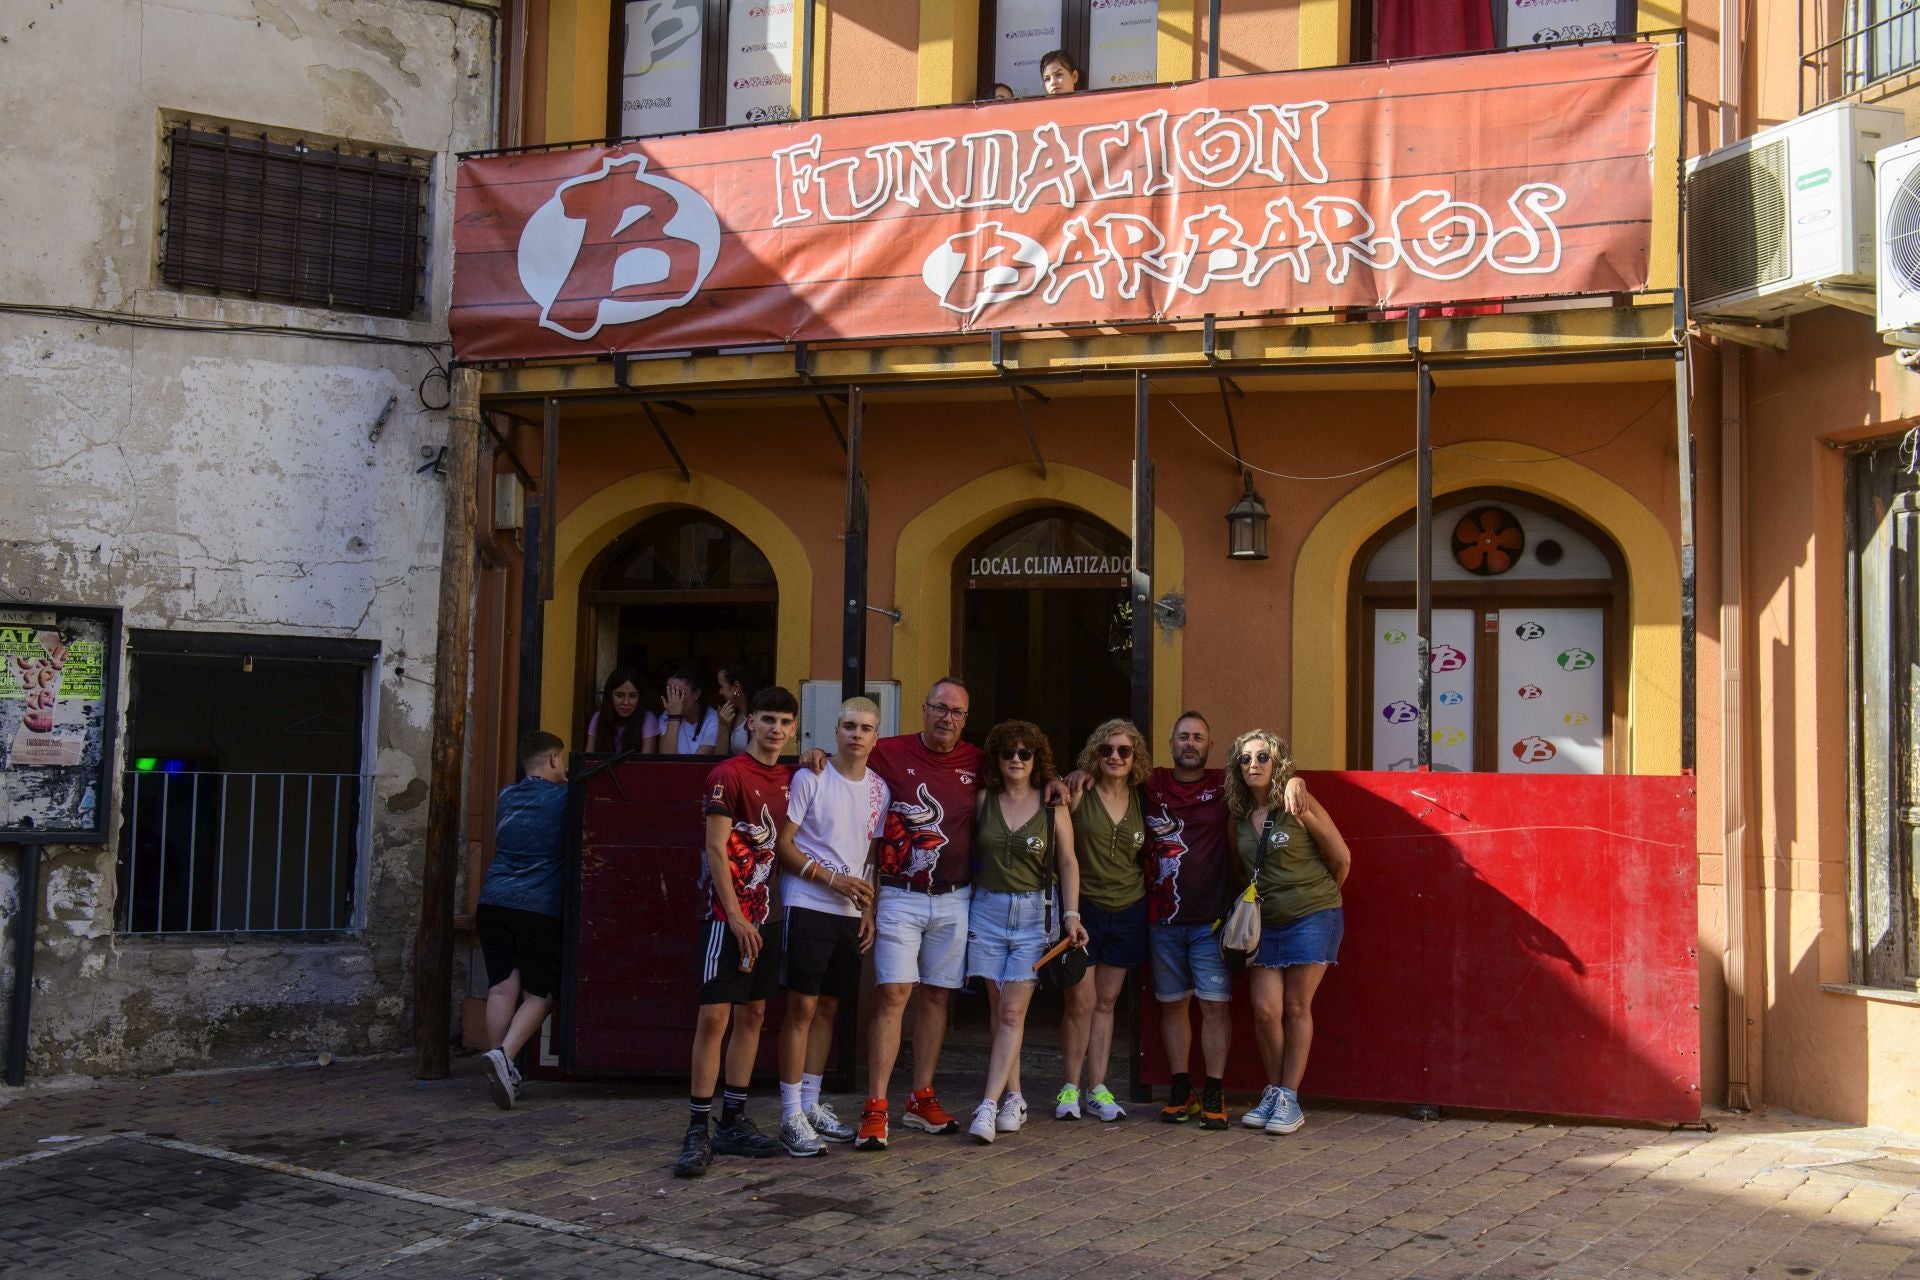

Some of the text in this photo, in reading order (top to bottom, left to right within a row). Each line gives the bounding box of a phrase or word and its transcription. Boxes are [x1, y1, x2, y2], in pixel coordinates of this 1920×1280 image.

[773, 100, 1330, 227] FUNDACION
[922, 183, 1567, 313] BARBAROS
[970, 555, 1132, 576] LOCAL CLIMATIZADO
